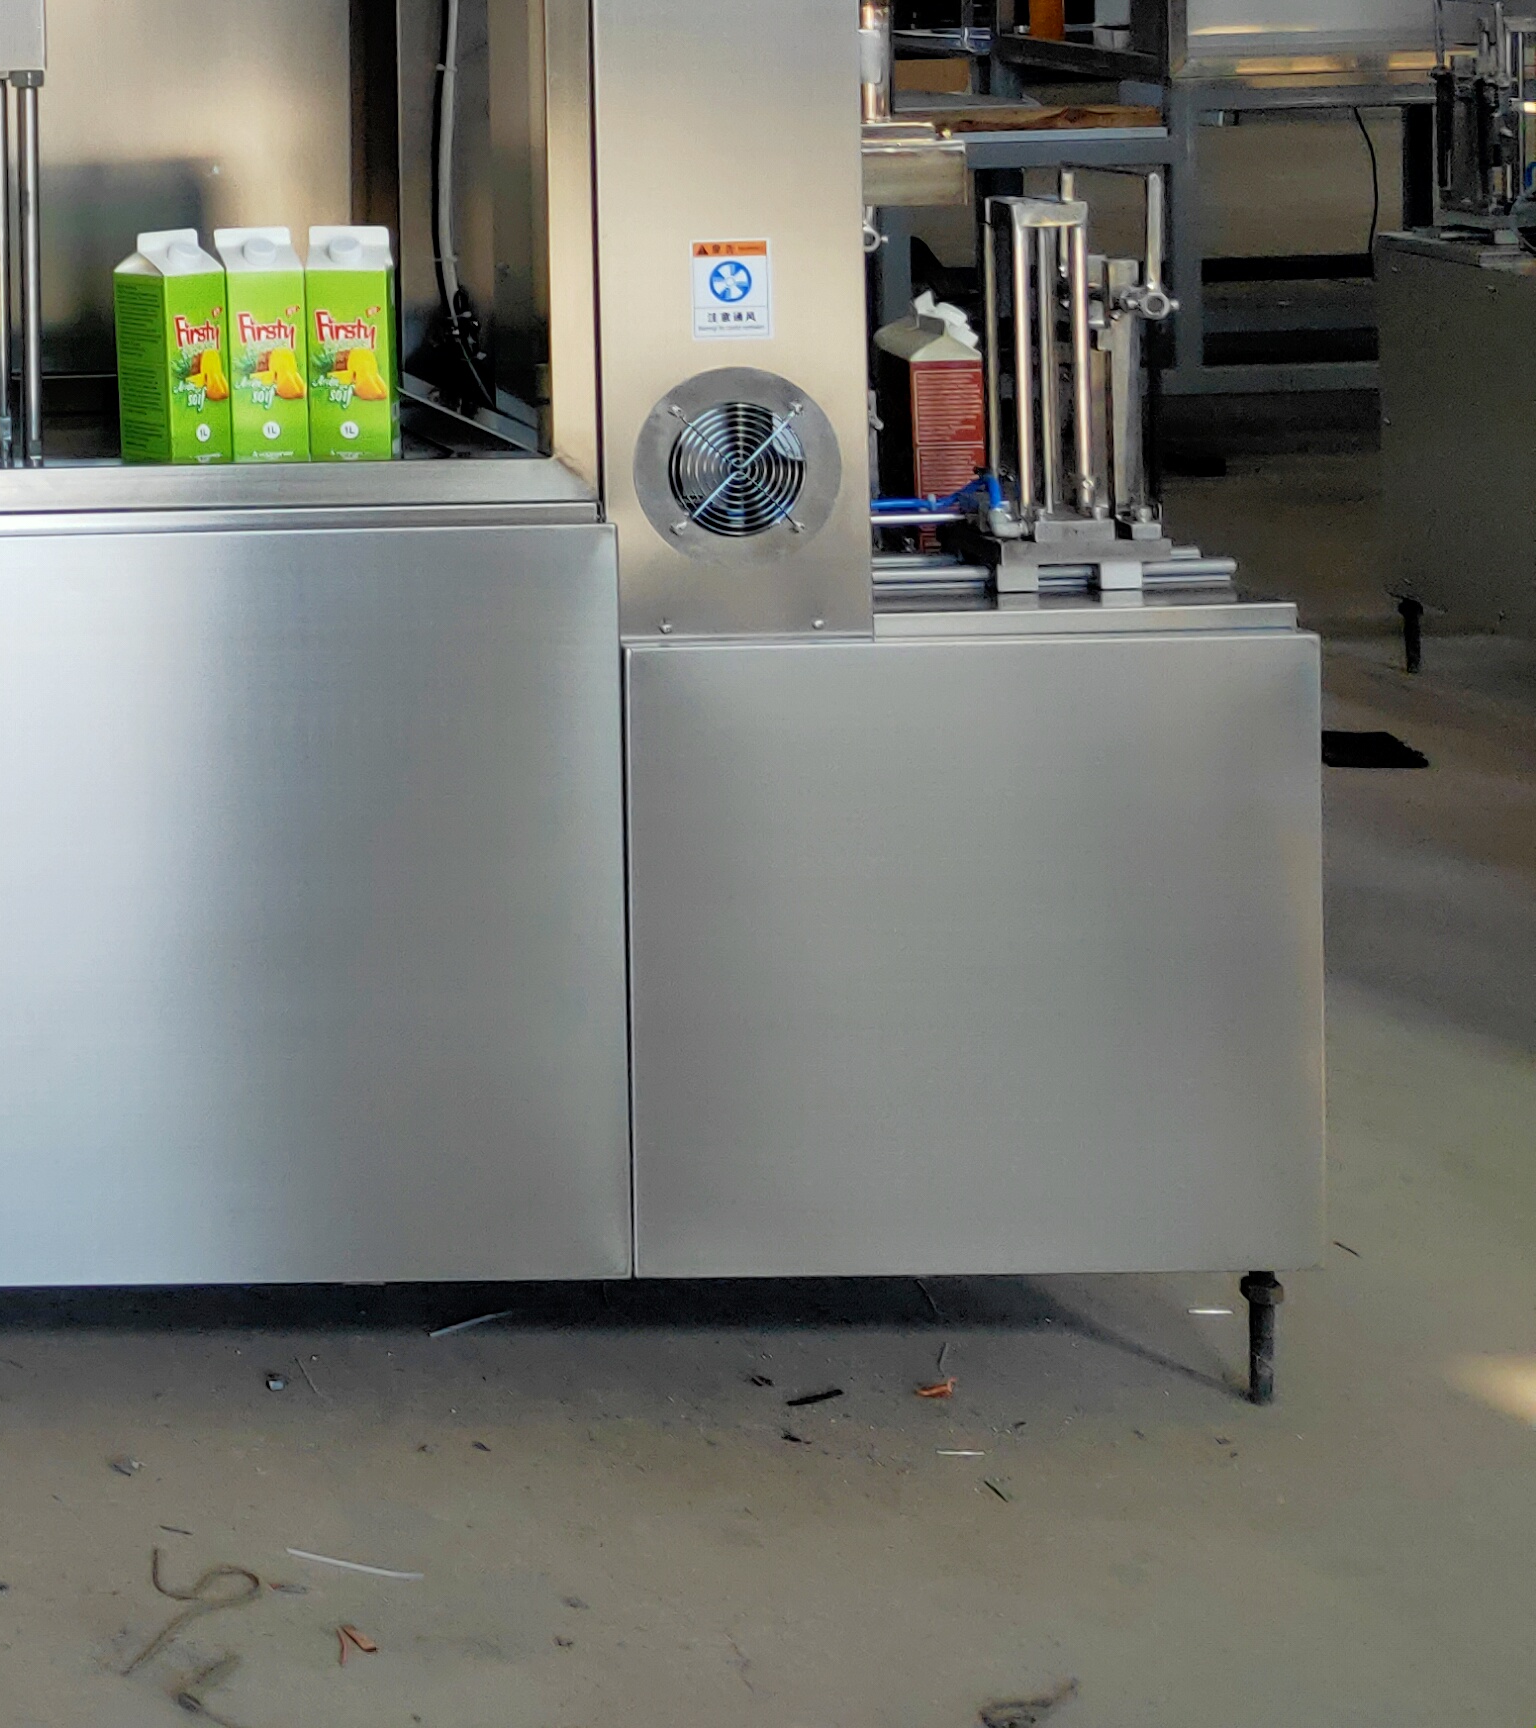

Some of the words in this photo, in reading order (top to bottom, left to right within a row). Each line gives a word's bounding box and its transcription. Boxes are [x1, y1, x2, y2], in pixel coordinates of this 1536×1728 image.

[174, 315, 220, 350] Firsty
[237, 311, 295, 350] Firsty
[315, 309, 376, 350] Firsty
[187, 387, 207, 412] soif
[252, 384, 277, 410] soif
[329, 384, 355, 410] soif
